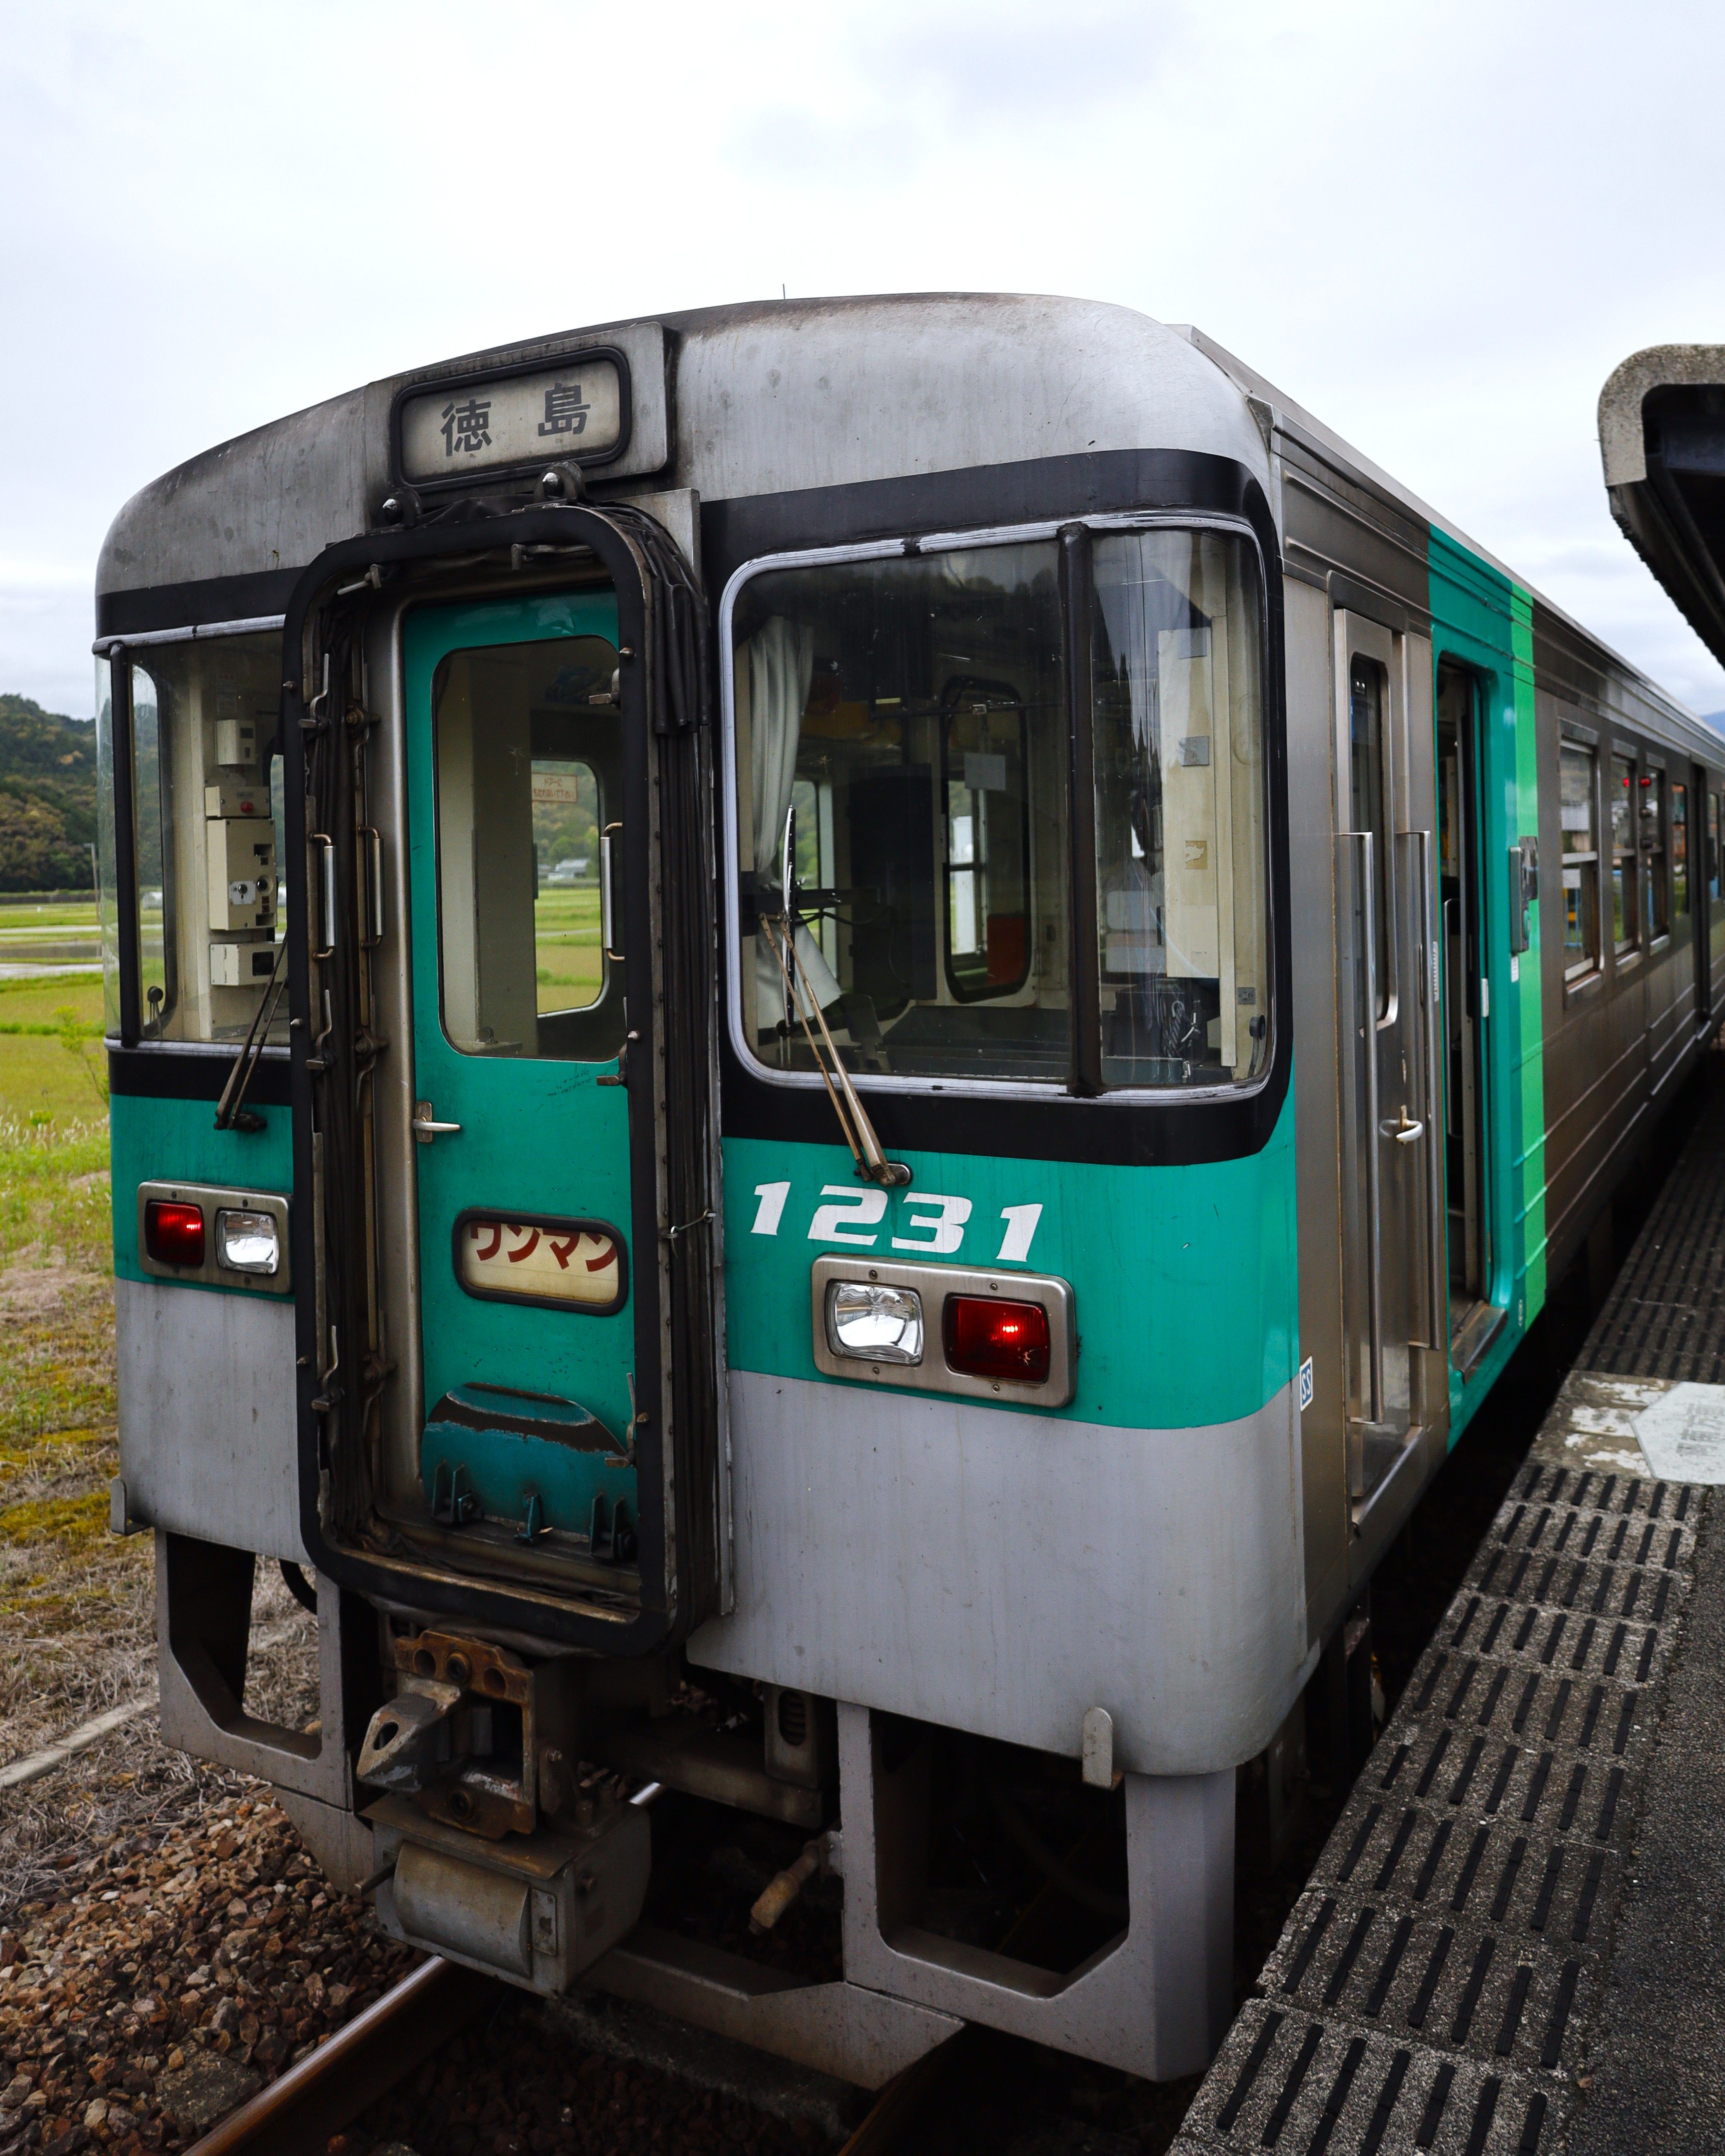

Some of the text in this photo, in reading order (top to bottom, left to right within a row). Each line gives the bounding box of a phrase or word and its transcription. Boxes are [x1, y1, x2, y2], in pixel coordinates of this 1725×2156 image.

[440, 382, 590, 456] 徳島
[470, 1222, 617, 1272] ワンマン
[750, 1181, 1043, 1262] 1231
[1301, 1368, 1311, 1401] SS
